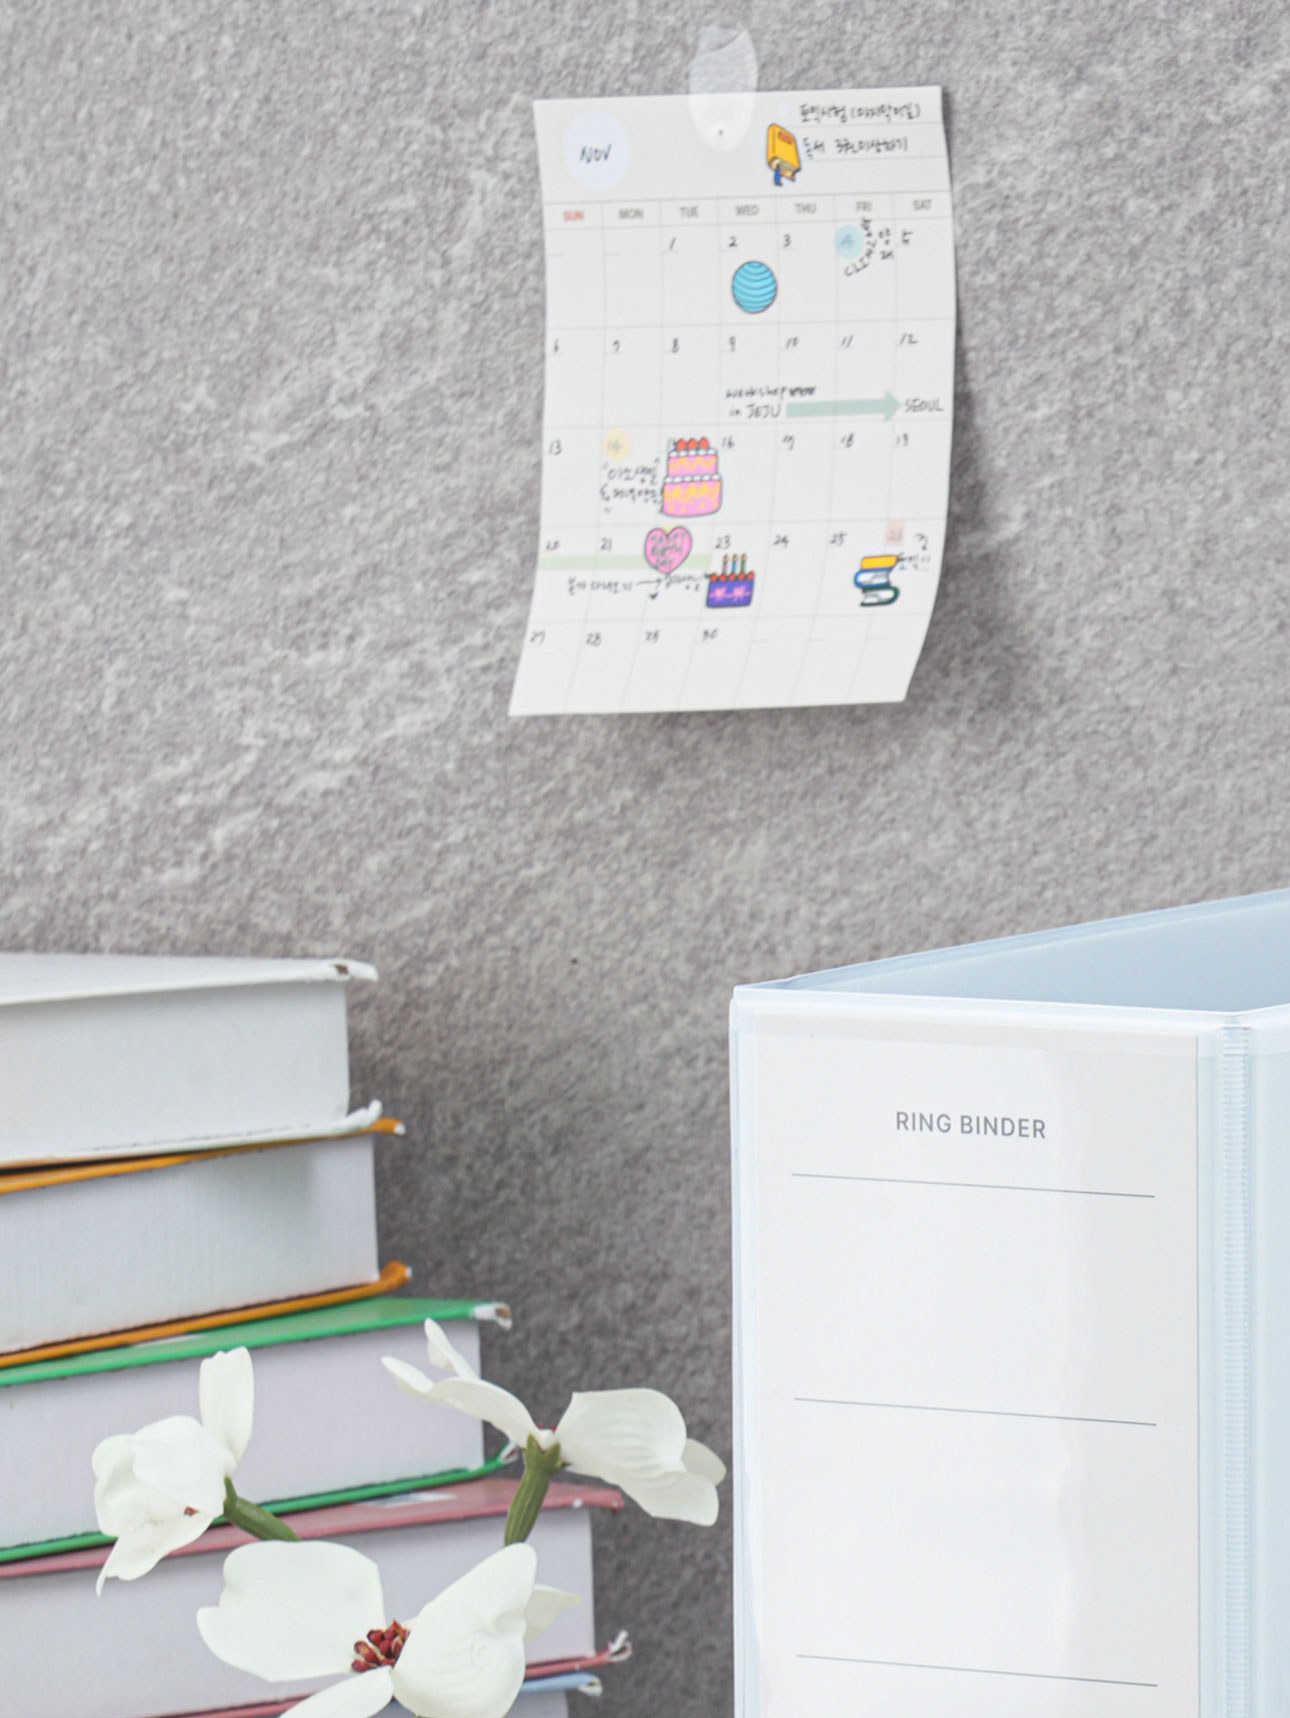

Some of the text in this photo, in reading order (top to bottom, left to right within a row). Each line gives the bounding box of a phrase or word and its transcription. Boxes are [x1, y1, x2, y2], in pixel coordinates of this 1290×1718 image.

[580, 144, 612, 164] NOV
[735, 204, 760, 217] WED
[794, 202, 817, 215] THU
[912, 198, 933, 211] SAT
[562, 210, 585, 222] SUN
[618, 208, 644, 220] MON
[679, 205, 699, 218] TUE
[746, 403, 781, 419] JEJU
[905, 397, 944, 413] SEOUL
[897, 1112, 1045, 1138] RING BINDER
